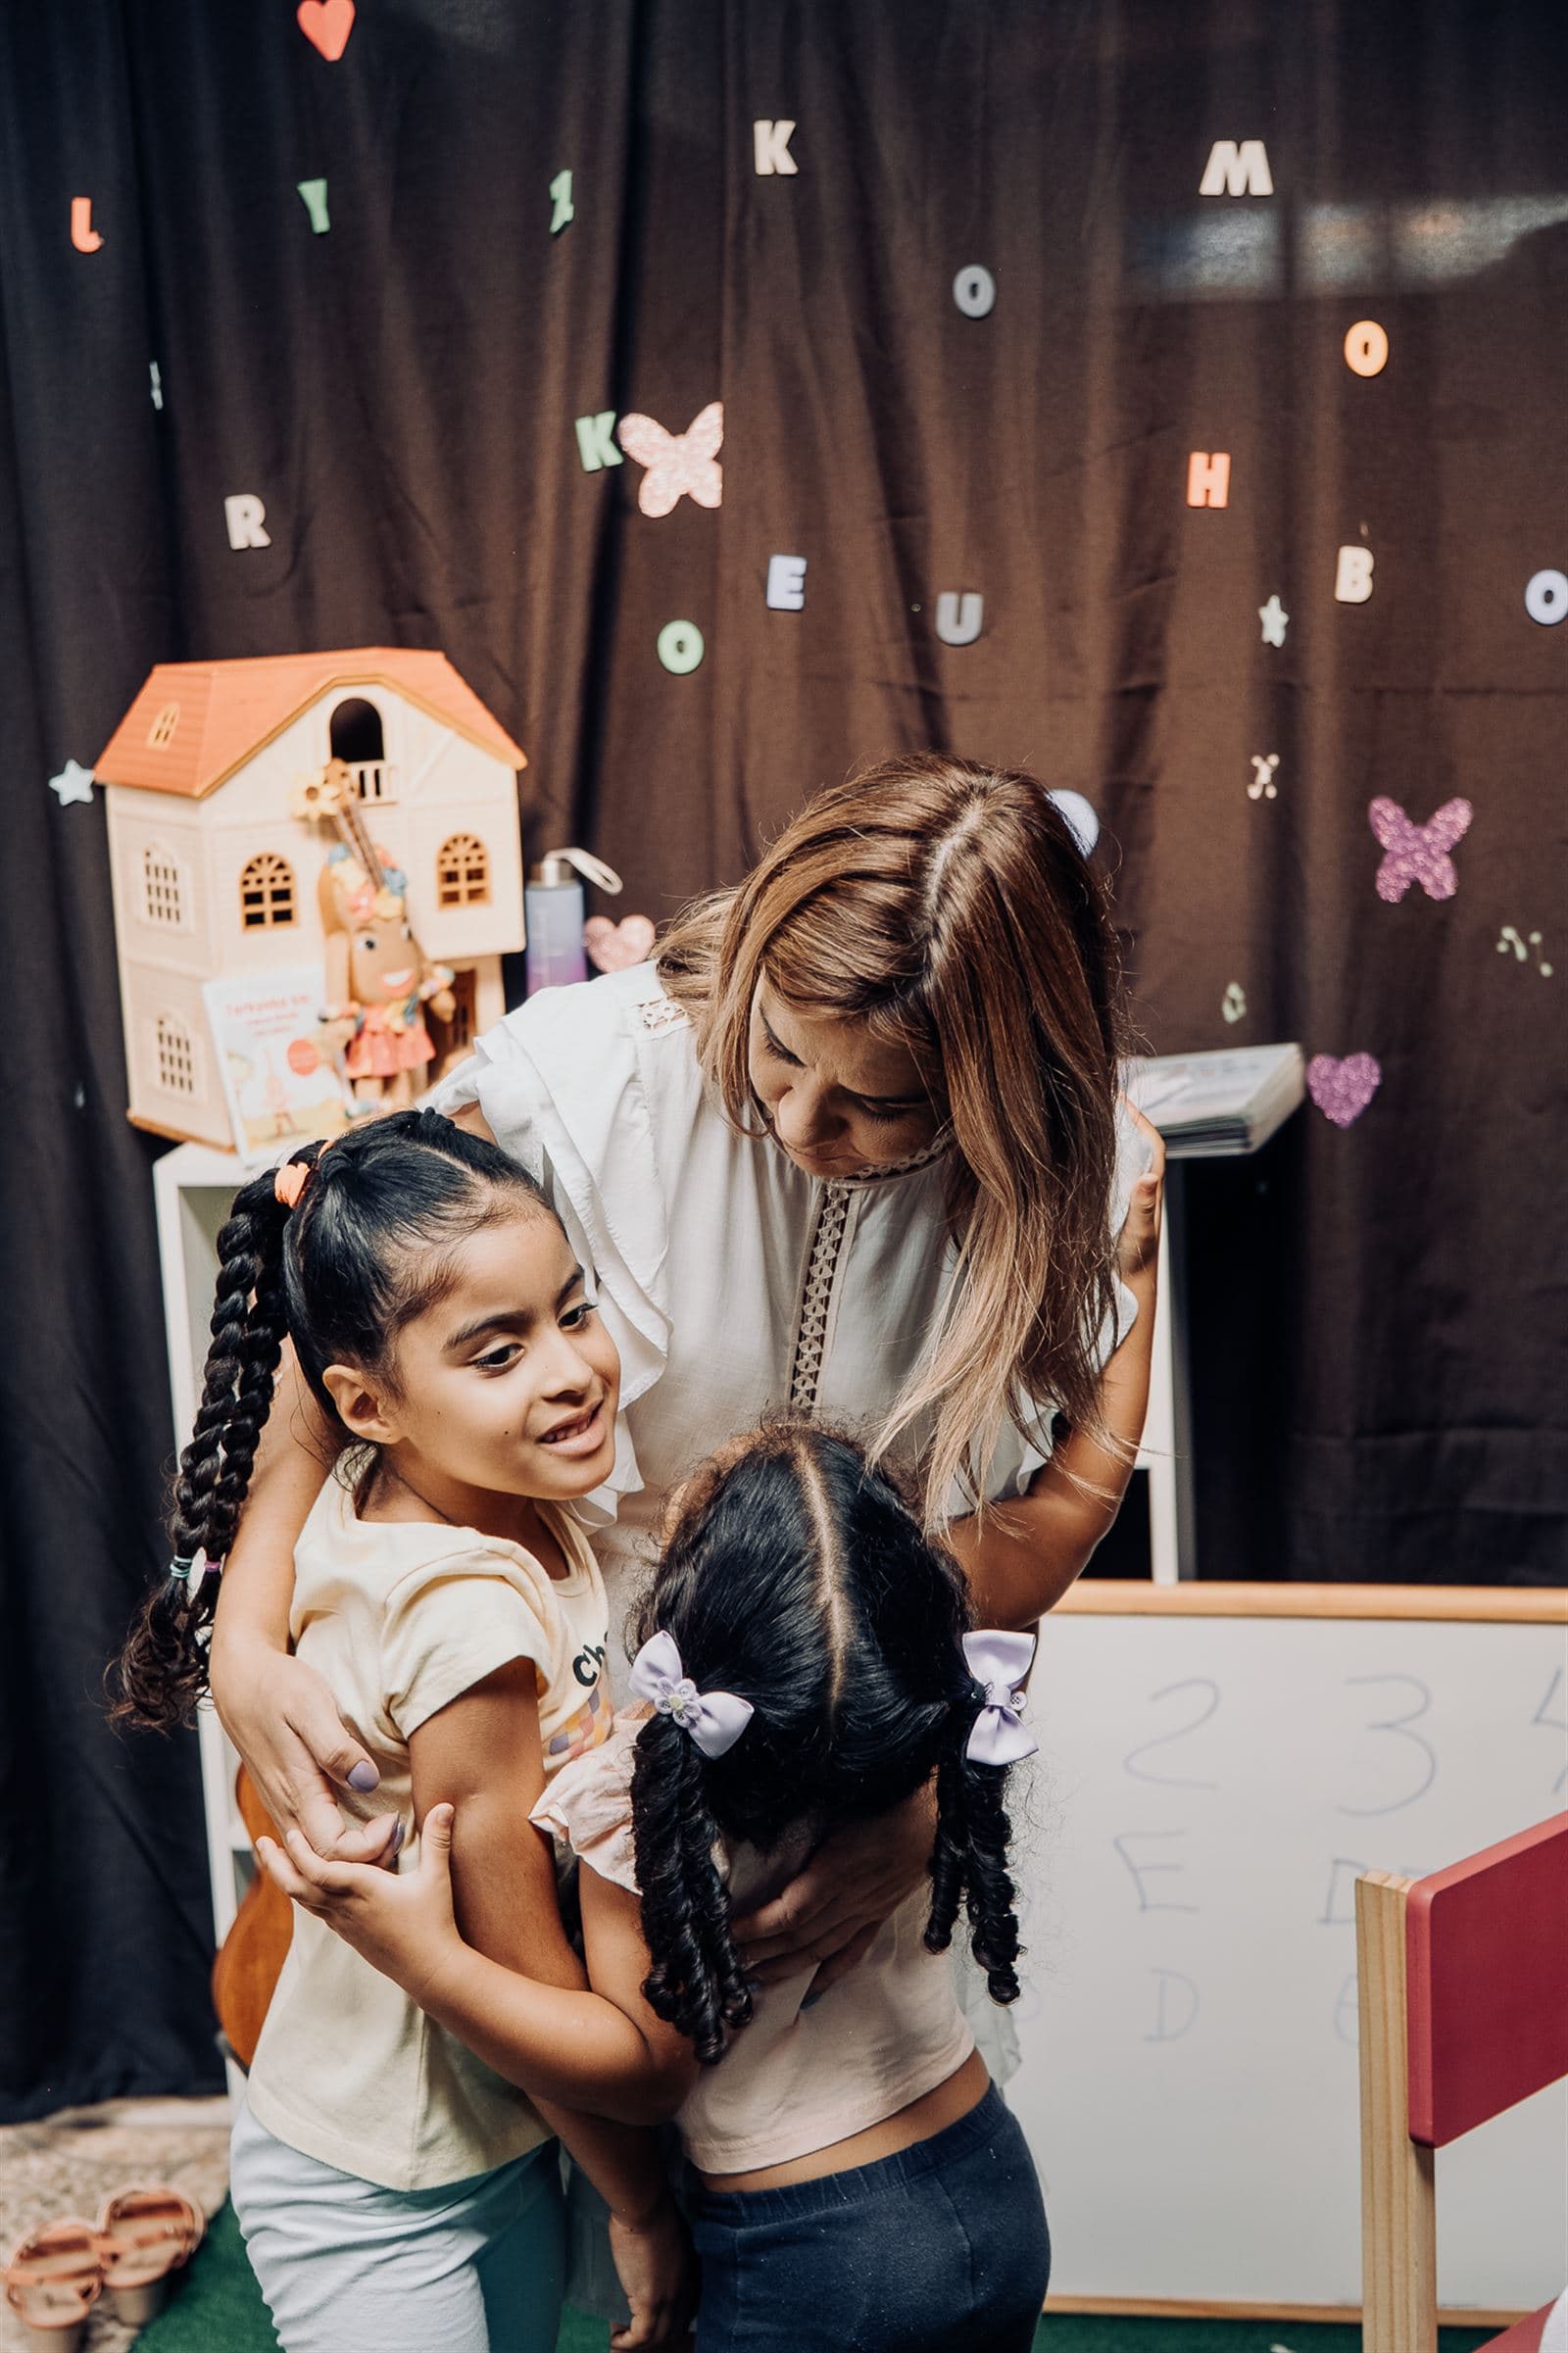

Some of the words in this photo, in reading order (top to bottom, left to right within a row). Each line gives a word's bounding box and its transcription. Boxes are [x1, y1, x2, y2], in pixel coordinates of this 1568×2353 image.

[754, 120, 799, 175] K
[1200, 140, 1274, 197] M
[297, 178, 331, 234] Y
[1344, 319, 1389, 378] O
[575, 411, 623, 472] K
[1187, 451, 1231, 509] H
[224, 494, 271, 551] R
[766, 555, 807, 610] E
[1334, 545, 1375, 604] B
[935, 591, 985, 646] U
[1124, 1677, 1220, 1790] 2
[1335, 1673, 1438, 1818] 3
[1144, 1966, 1201, 2043] D
